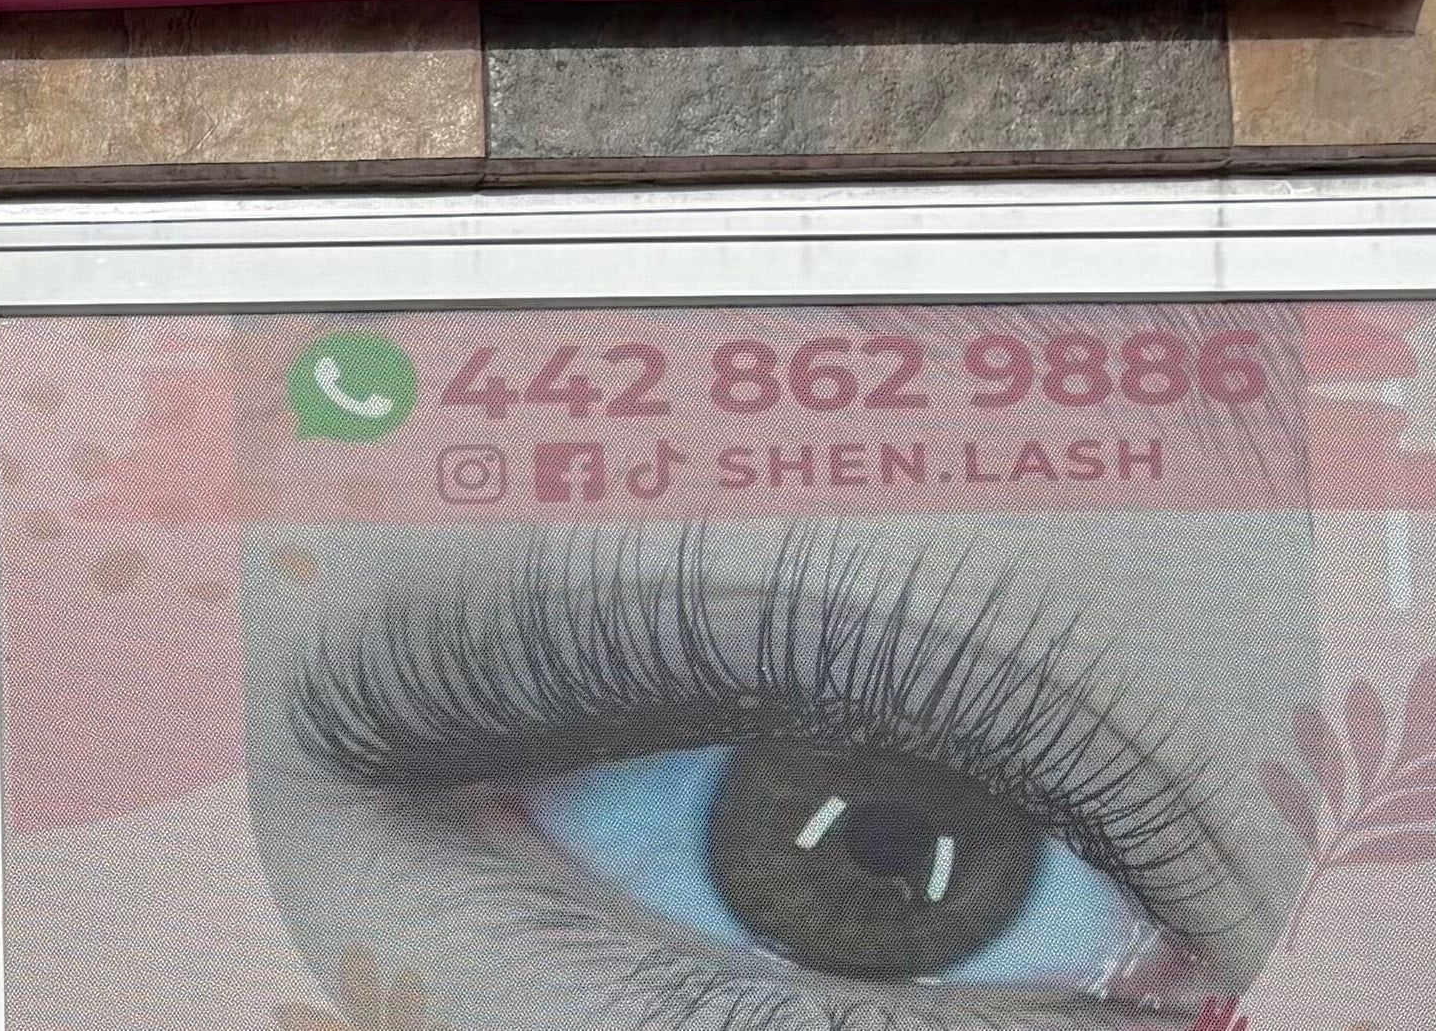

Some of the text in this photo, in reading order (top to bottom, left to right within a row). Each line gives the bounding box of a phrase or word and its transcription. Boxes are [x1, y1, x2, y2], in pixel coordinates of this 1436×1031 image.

[440, 330, 1266, 419] 442 862 9886
[716, 438, 1166, 490] SHEN.LASH
